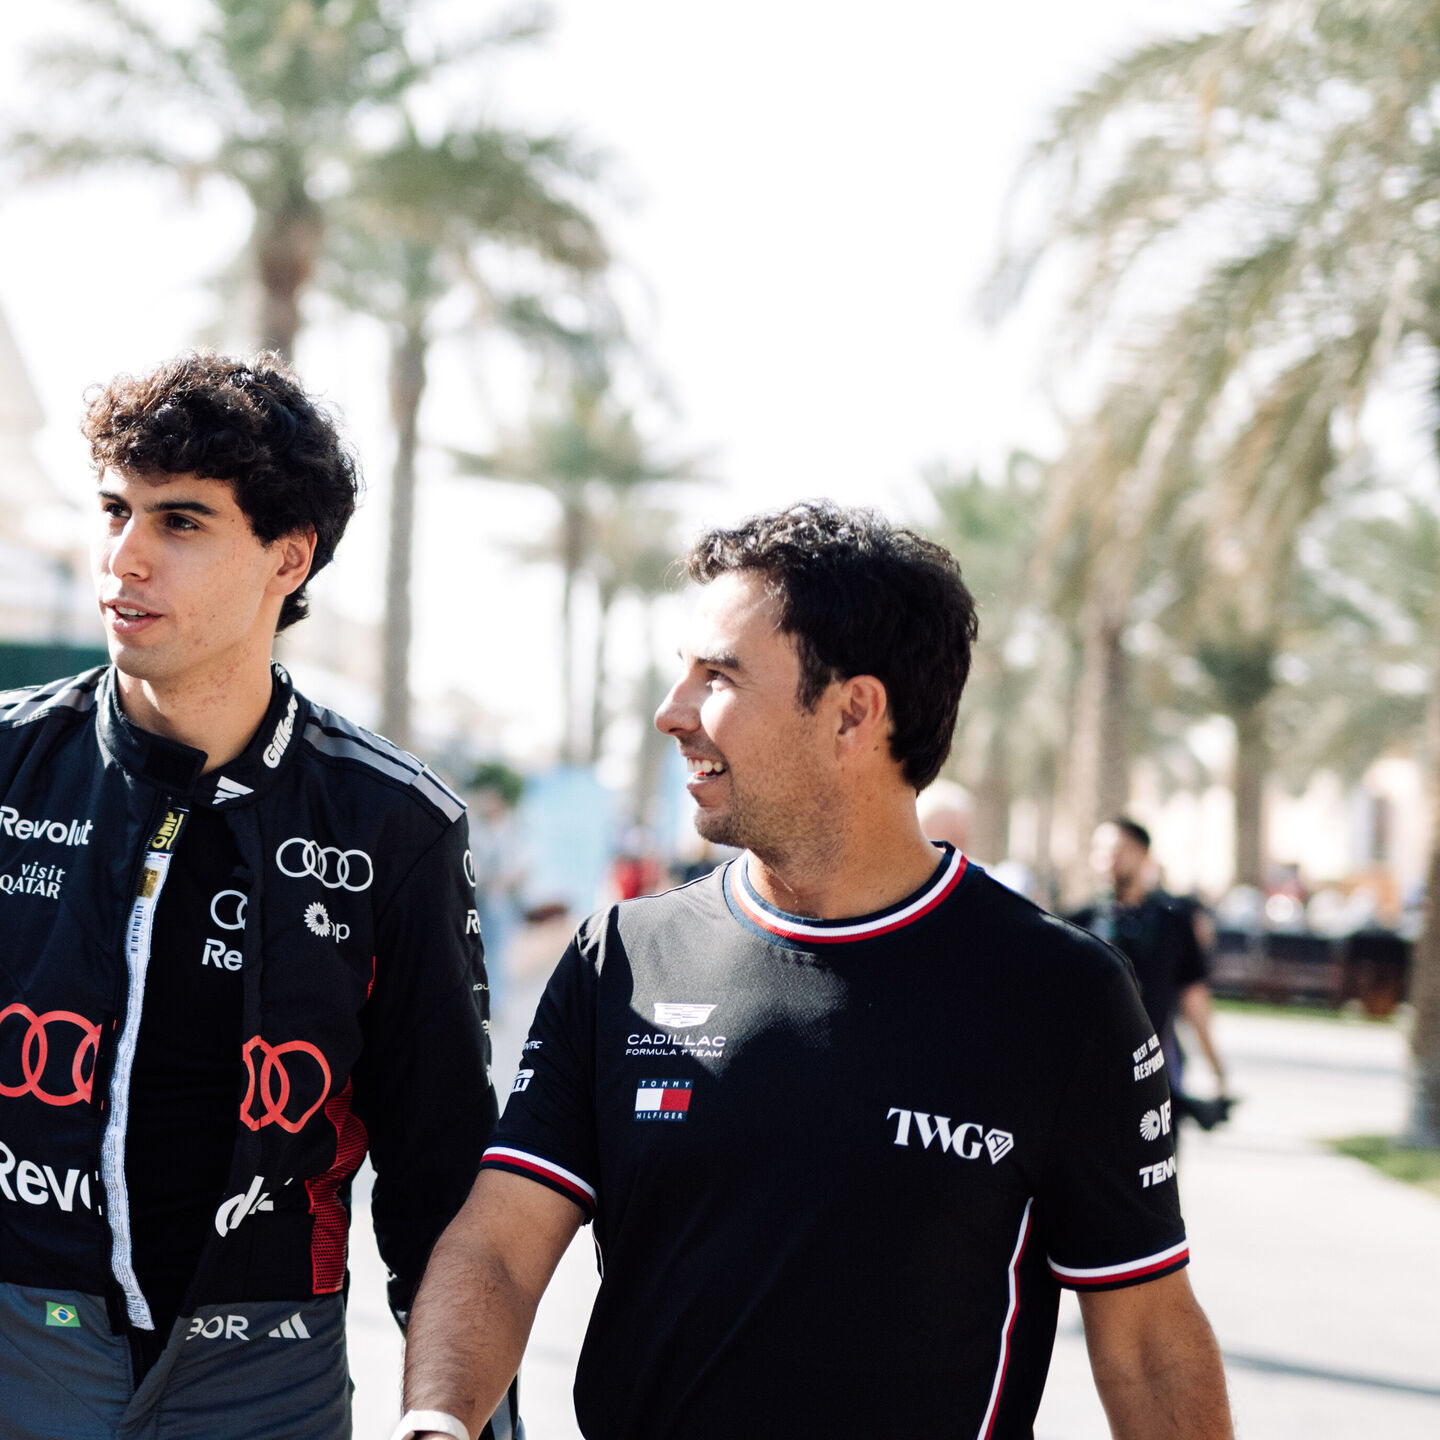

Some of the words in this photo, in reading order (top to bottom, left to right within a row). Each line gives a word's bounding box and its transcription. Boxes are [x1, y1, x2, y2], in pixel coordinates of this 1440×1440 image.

[21, 861, 66, 883] visit
[627, 1034, 727, 1048] CADILLAC
[625, 1048, 677, 1056] FORMULA
[689, 1049, 723, 1058] TEAM
[636, 1112, 683, 1120] HILFIGER
[886, 1107, 983, 1160] TWG
